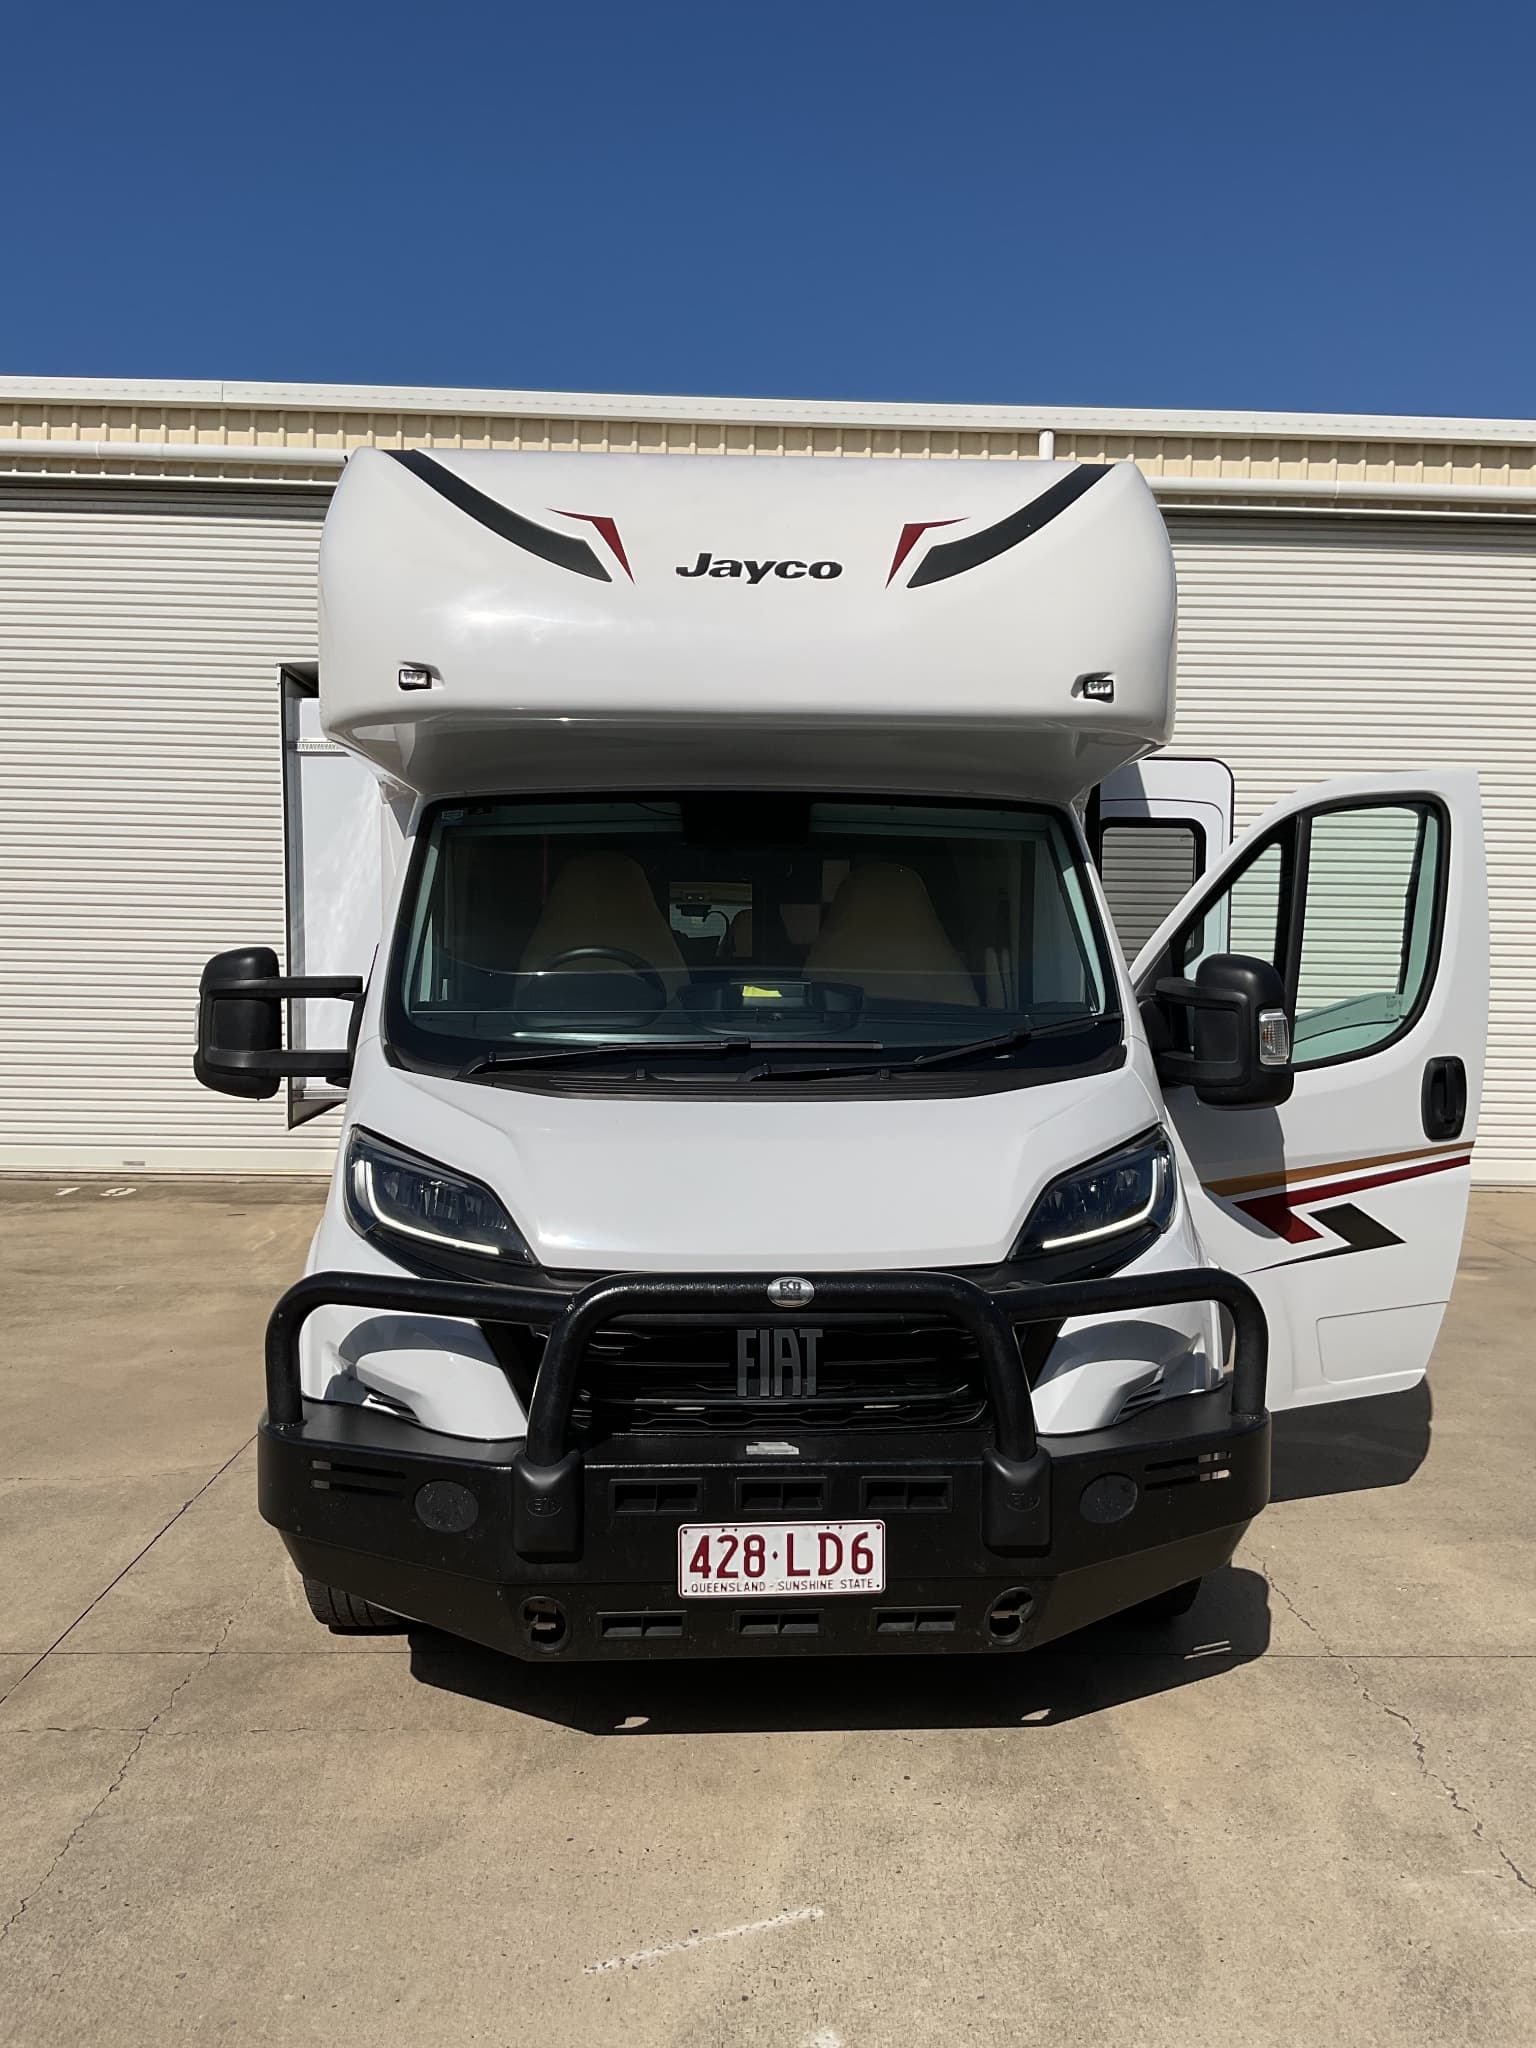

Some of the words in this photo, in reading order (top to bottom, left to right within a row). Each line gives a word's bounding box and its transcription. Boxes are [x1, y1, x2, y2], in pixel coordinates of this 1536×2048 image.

[675, 552, 843, 585] Jayco
[736, 1328, 824, 1397] FIAT
[691, 1581, 766, 1593] QUEENSLAND
[777, 1579, 834, 1592] SUNSHINE
[840, 1578, 874, 1589] STATE
